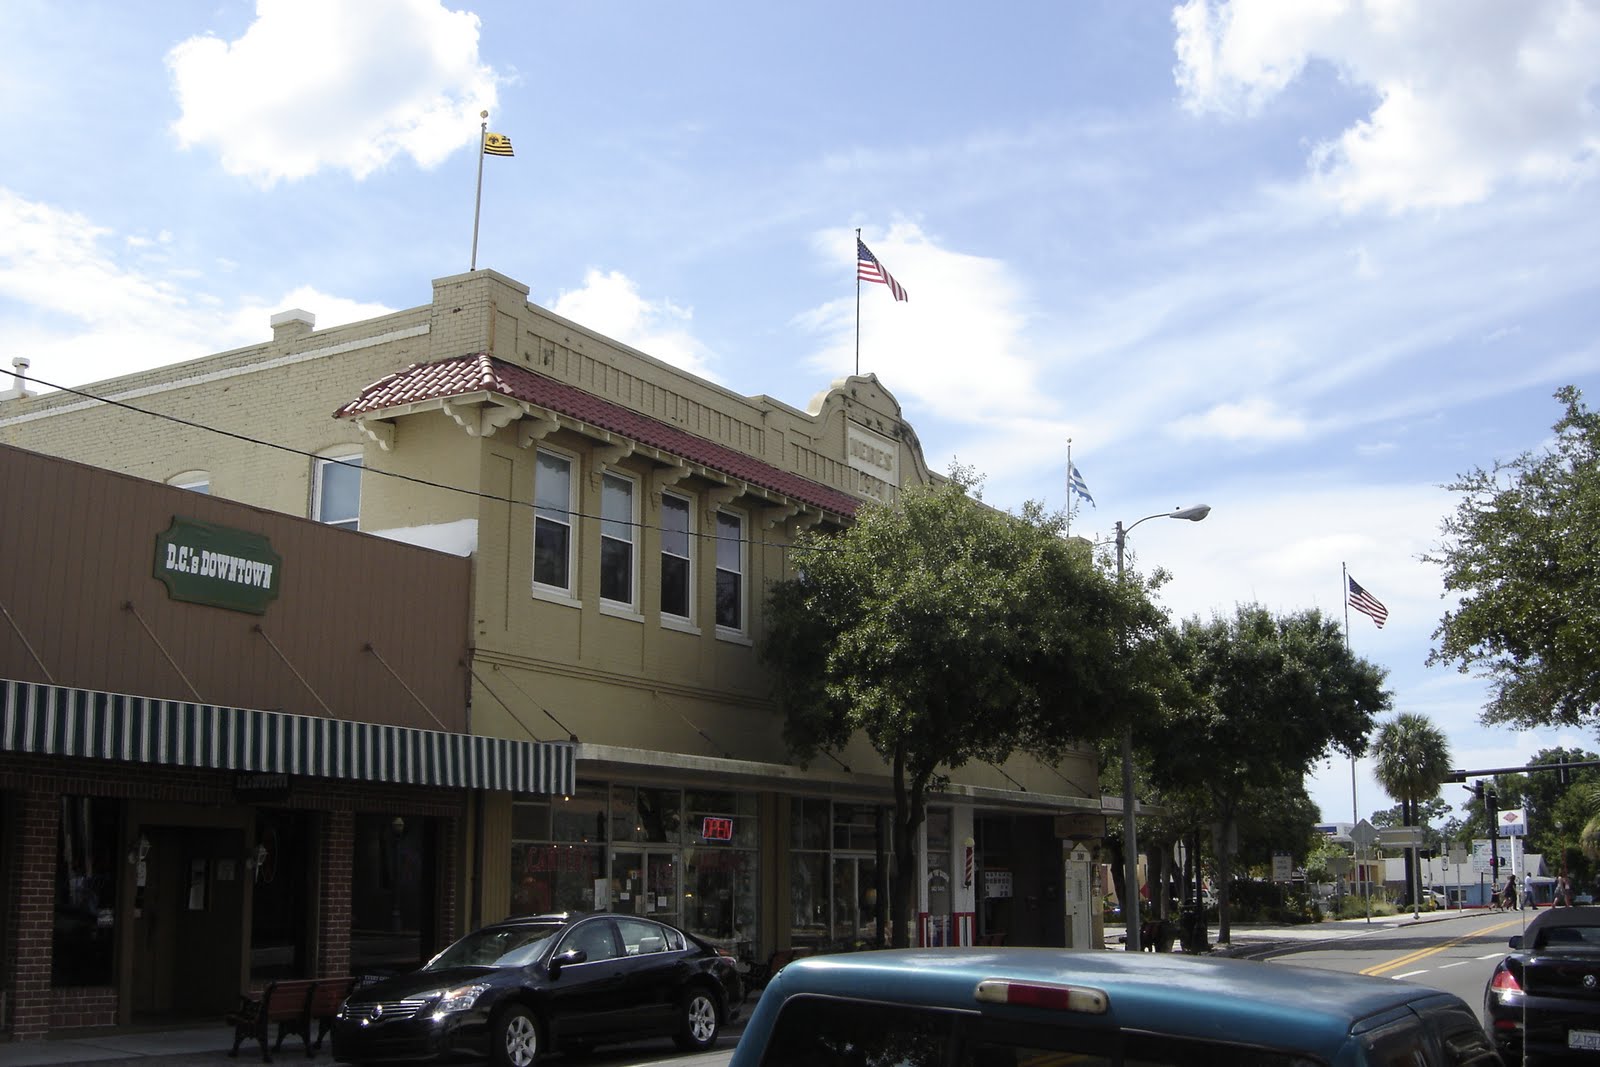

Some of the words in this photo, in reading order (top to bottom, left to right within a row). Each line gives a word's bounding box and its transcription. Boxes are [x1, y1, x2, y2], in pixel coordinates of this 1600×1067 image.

[166, 543, 200, 574] D.C.'s
[200, 550, 273, 589] DOWNTOWN
[704, 819, 731, 839] OPEN
